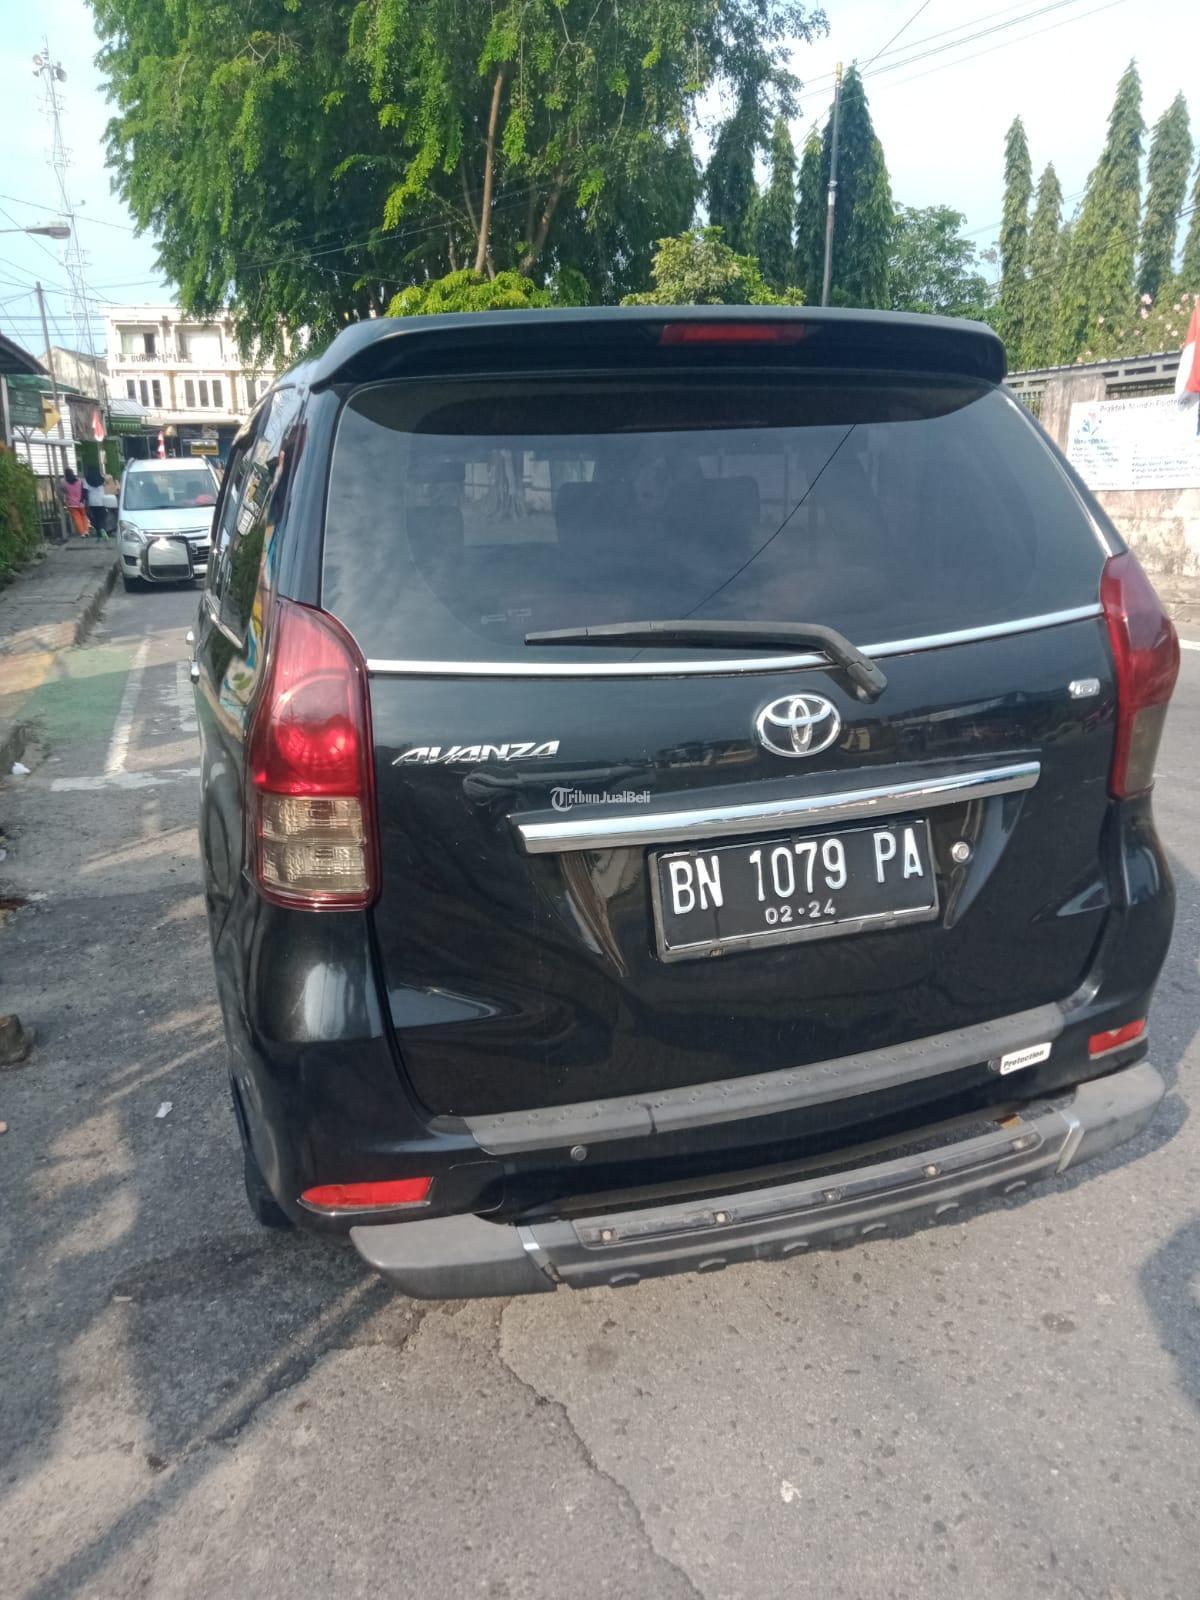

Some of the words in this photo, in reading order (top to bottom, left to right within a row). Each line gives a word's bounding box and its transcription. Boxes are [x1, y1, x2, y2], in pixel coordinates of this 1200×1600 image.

[392, 740, 560, 765] AVANZA
[669, 855, 724, 915] BN
[750, 838, 848, 902] 1079
[873, 827, 924, 883] PA
